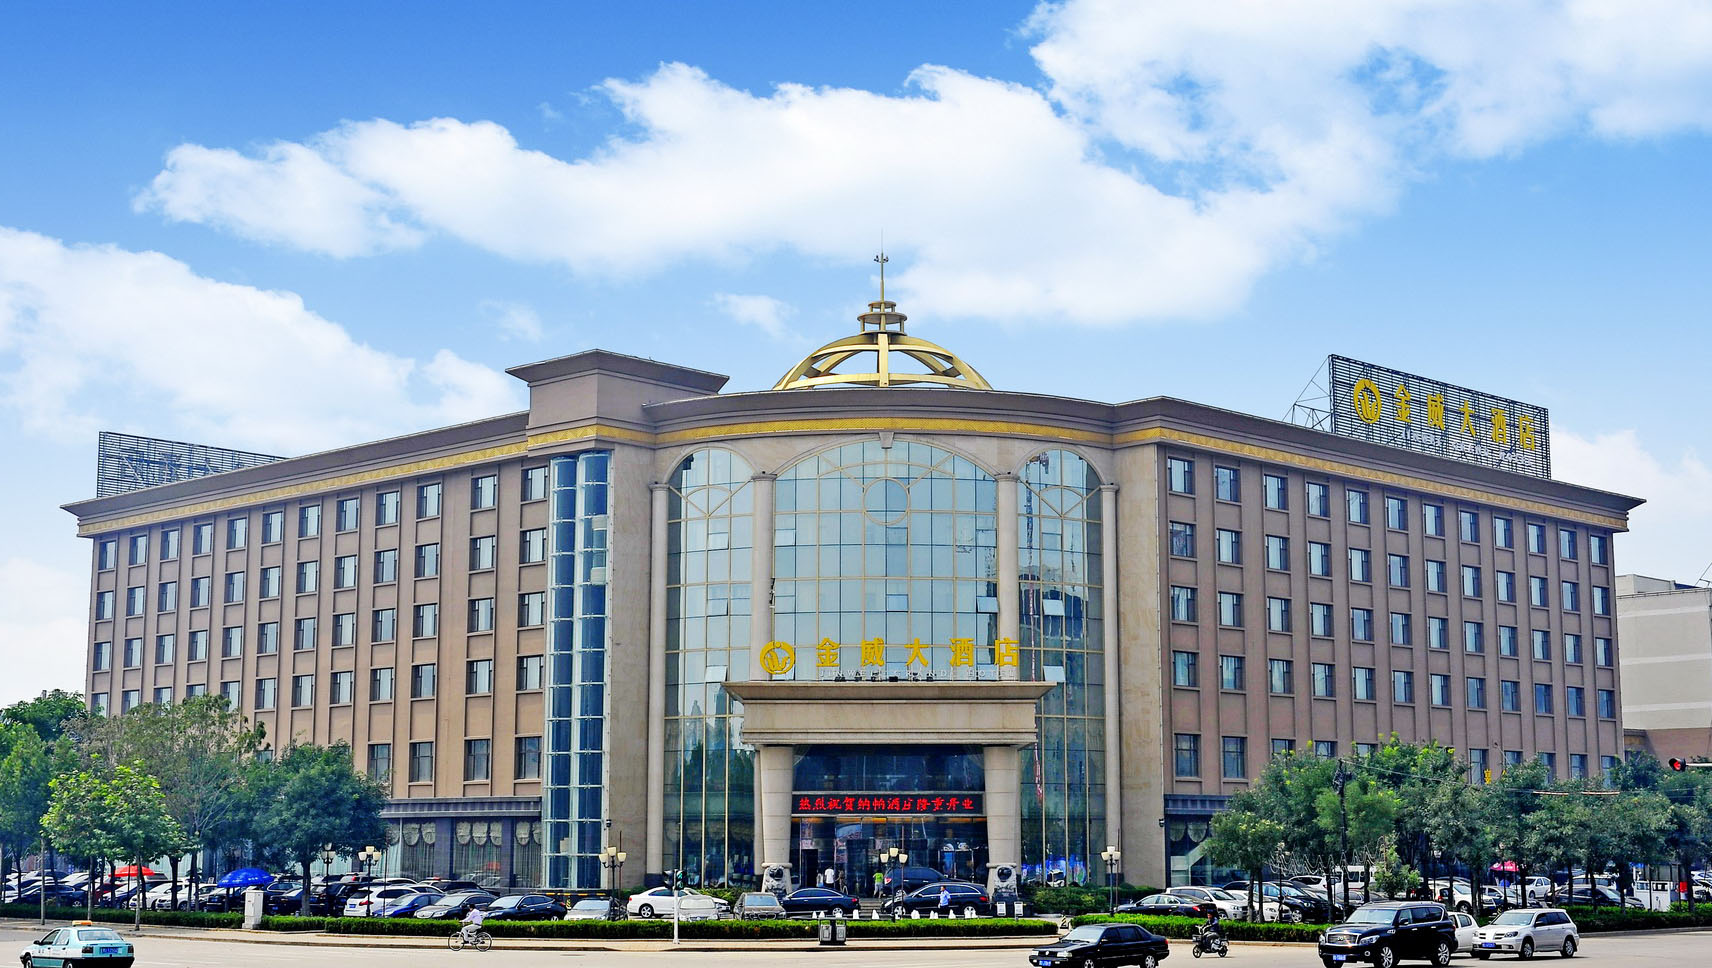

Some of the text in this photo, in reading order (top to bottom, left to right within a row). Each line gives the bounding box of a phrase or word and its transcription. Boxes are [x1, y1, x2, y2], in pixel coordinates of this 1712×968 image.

[1394, 383, 1536, 451] 金威大酒店
[815, 637, 1019, 667] 金威大酒店
